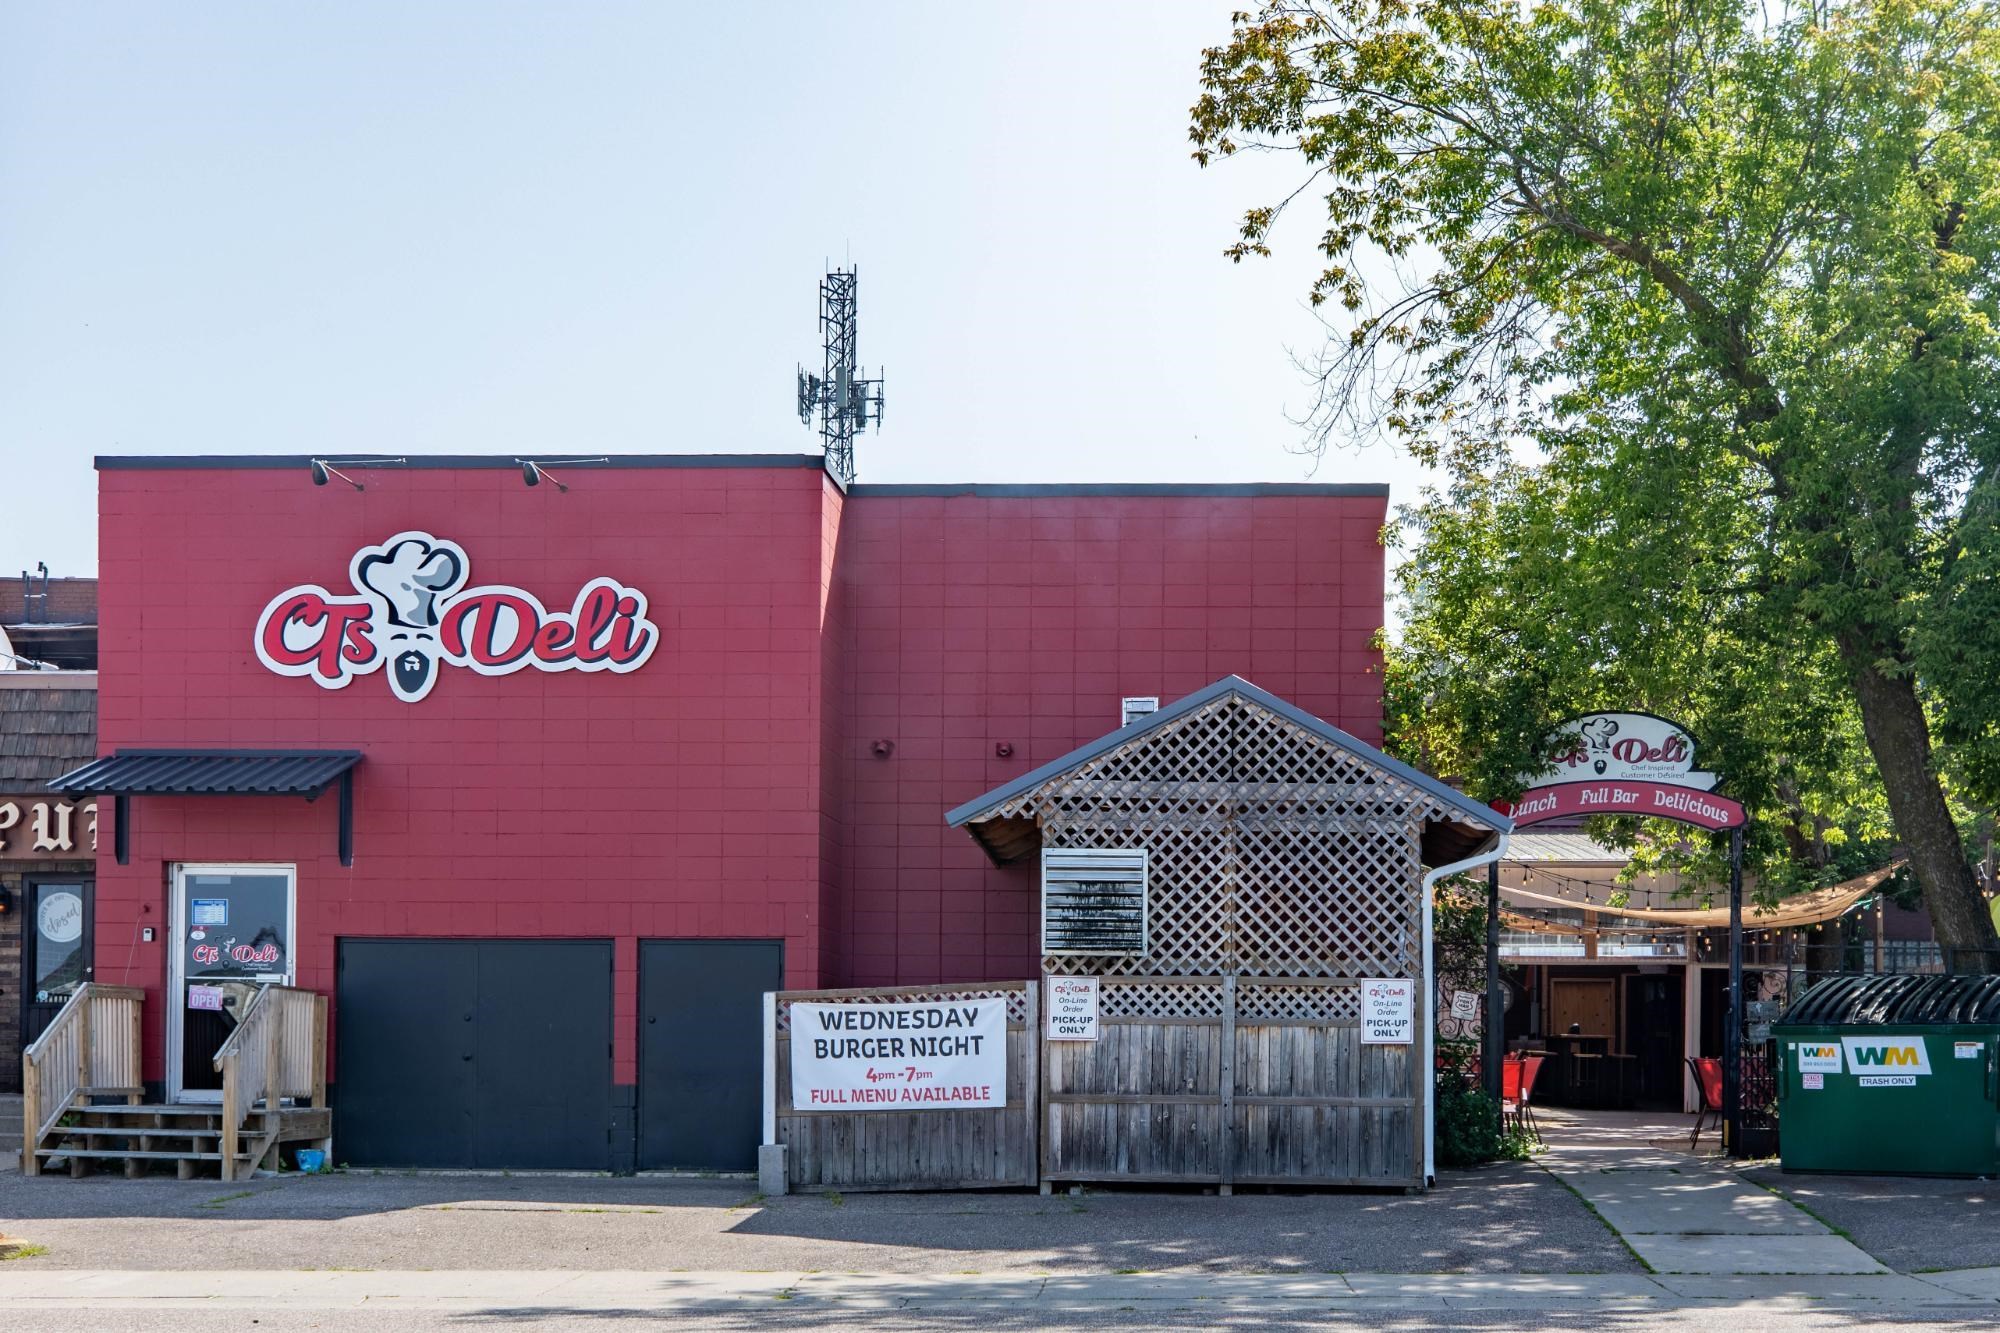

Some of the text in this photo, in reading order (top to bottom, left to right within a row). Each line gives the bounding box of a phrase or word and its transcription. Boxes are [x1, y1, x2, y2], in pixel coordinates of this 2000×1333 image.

[440, 586, 649, 665] Deli
[1612, 735, 1689, 764] Deli
[1648, 764, 1675, 772] Inspired
[1509, 788, 1728, 823] Lunch Full Bar Deli/cious
[232, 943, 278, 963] Deli
[191, 994, 219, 1008] OPEN
[1063, 1005, 1083, 1013] Order
[818, 1008, 979, 1030] WEDNESDAY
[1052, 1016, 1093, 1024] PICK-UP
[1367, 1019, 1408, 1027] PICK-UP
[1059, 1026, 1086, 1034] ONLY
[1374, 1029, 1401, 1037] ONLY
[814, 1035, 984, 1059] BURGER NIGHT
[1803, 1047, 1835, 1057] WM
[1854, 1047, 1919, 1066] WM
[1861, 1077, 1914, 1086] TRASH ONLY
[811, 1086, 991, 1103] FULL MENU AVAILABLE
